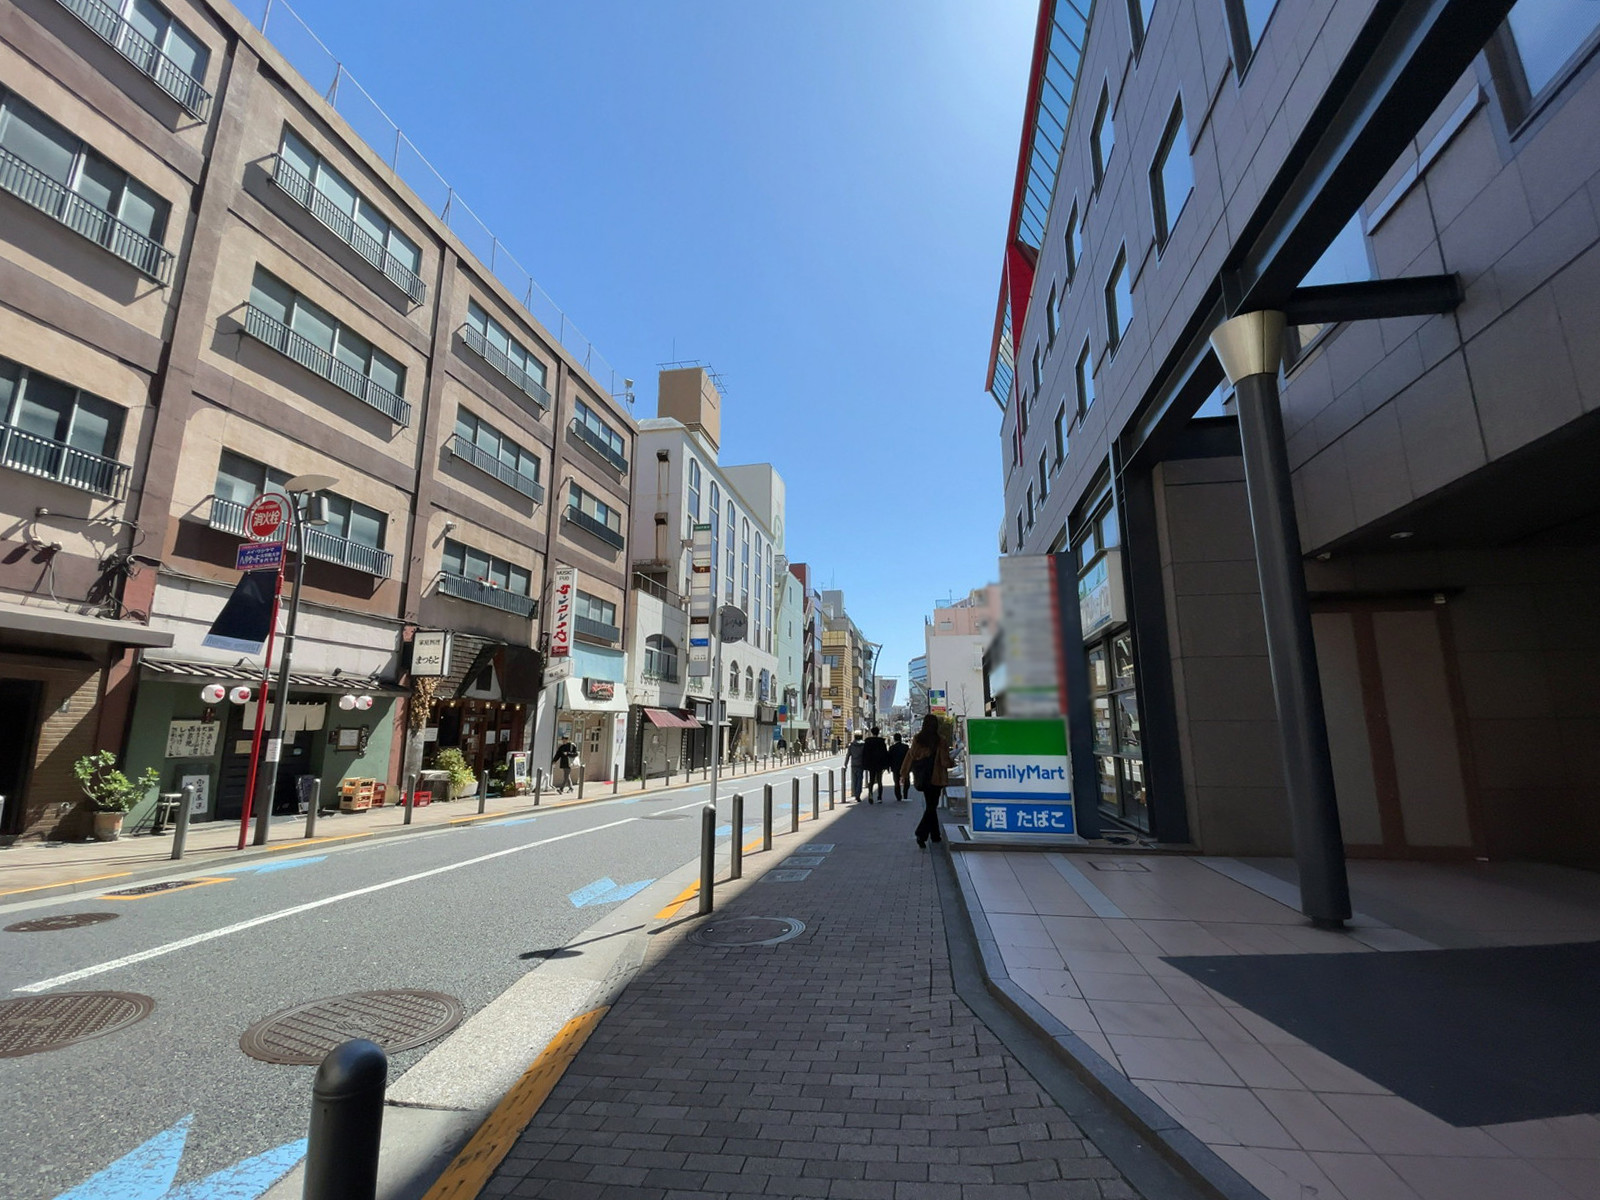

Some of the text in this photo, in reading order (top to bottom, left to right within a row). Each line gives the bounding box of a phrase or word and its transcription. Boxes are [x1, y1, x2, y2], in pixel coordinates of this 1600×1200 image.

[253, 510, 280, 527] 消火栓
[415, 655, 440, 665] まつもと
[975, 764, 1065, 783] FamilyMart
[985, 806, 1066, 830] 酒 たばこ
